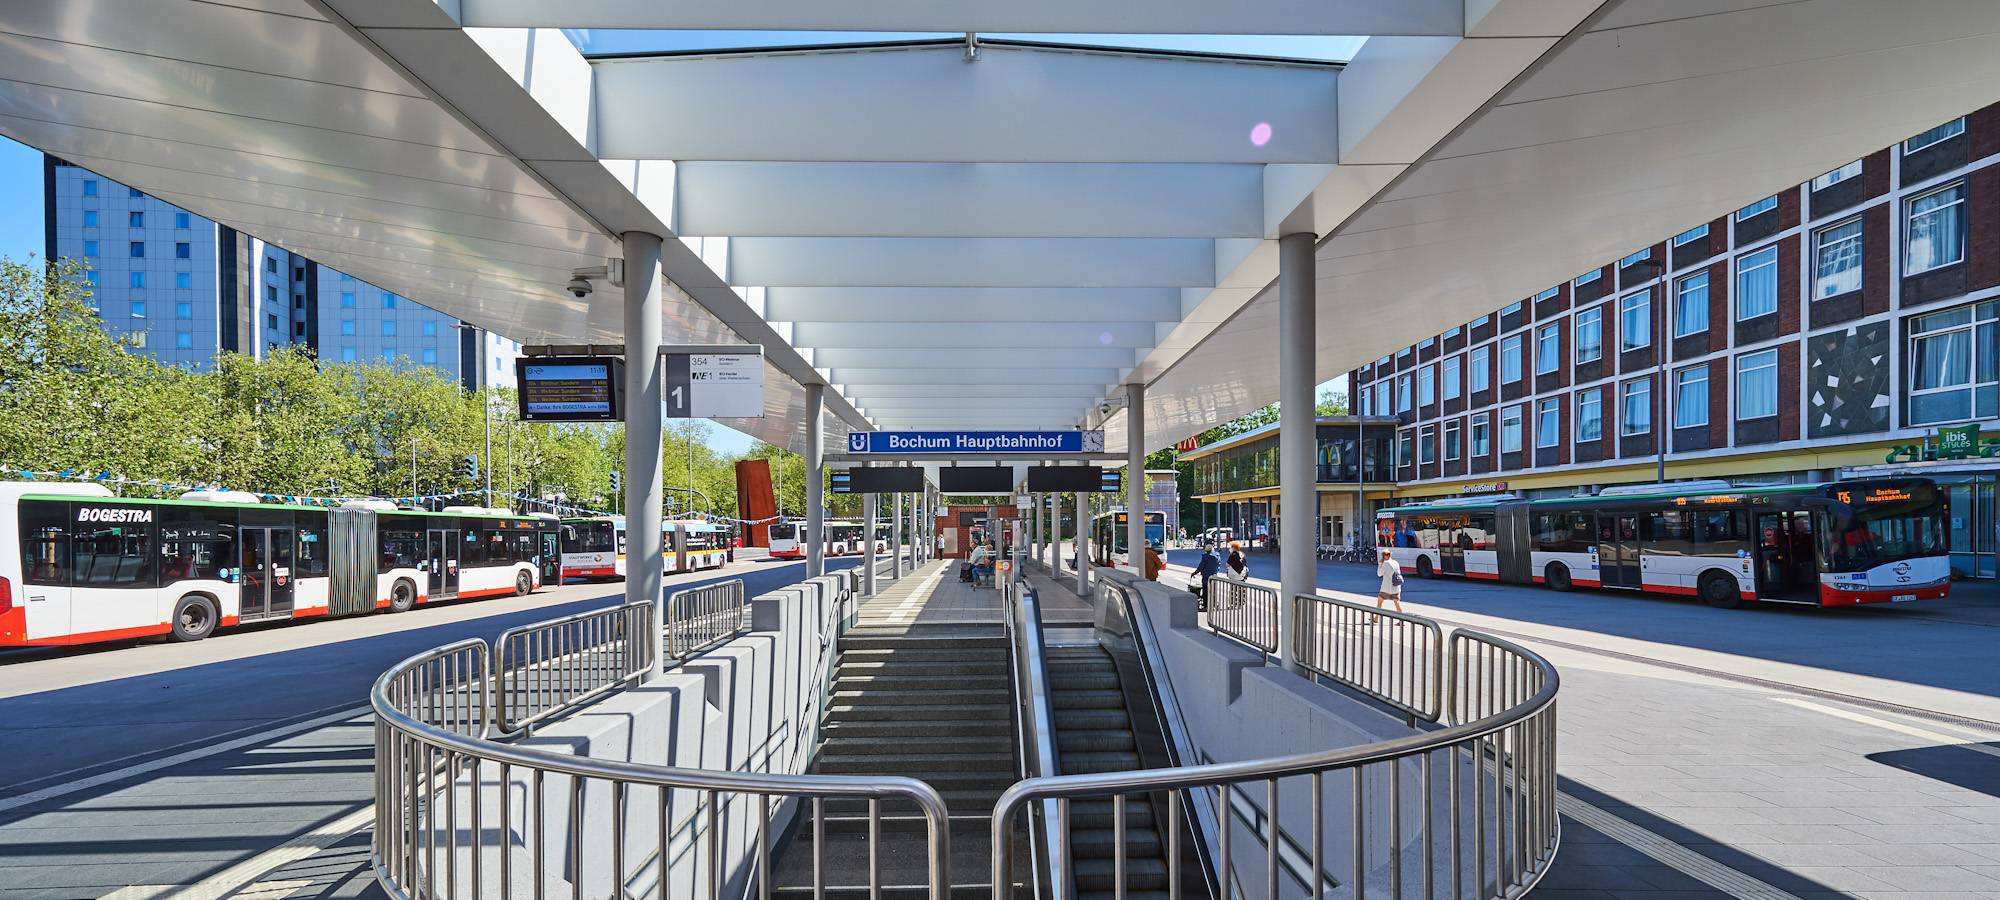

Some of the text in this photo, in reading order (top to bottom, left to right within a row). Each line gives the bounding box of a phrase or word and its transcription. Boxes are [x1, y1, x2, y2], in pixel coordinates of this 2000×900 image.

[691, 357, 708, 366] 354
[671, 386, 683, 409] 1
[889, 435, 951, 448] Bochum
[956, 434, 1064, 450] Hauptbahnhof
[1945, 431, 1967, 442] ibis
[77, 507, 153, 523] BOGESTRA
